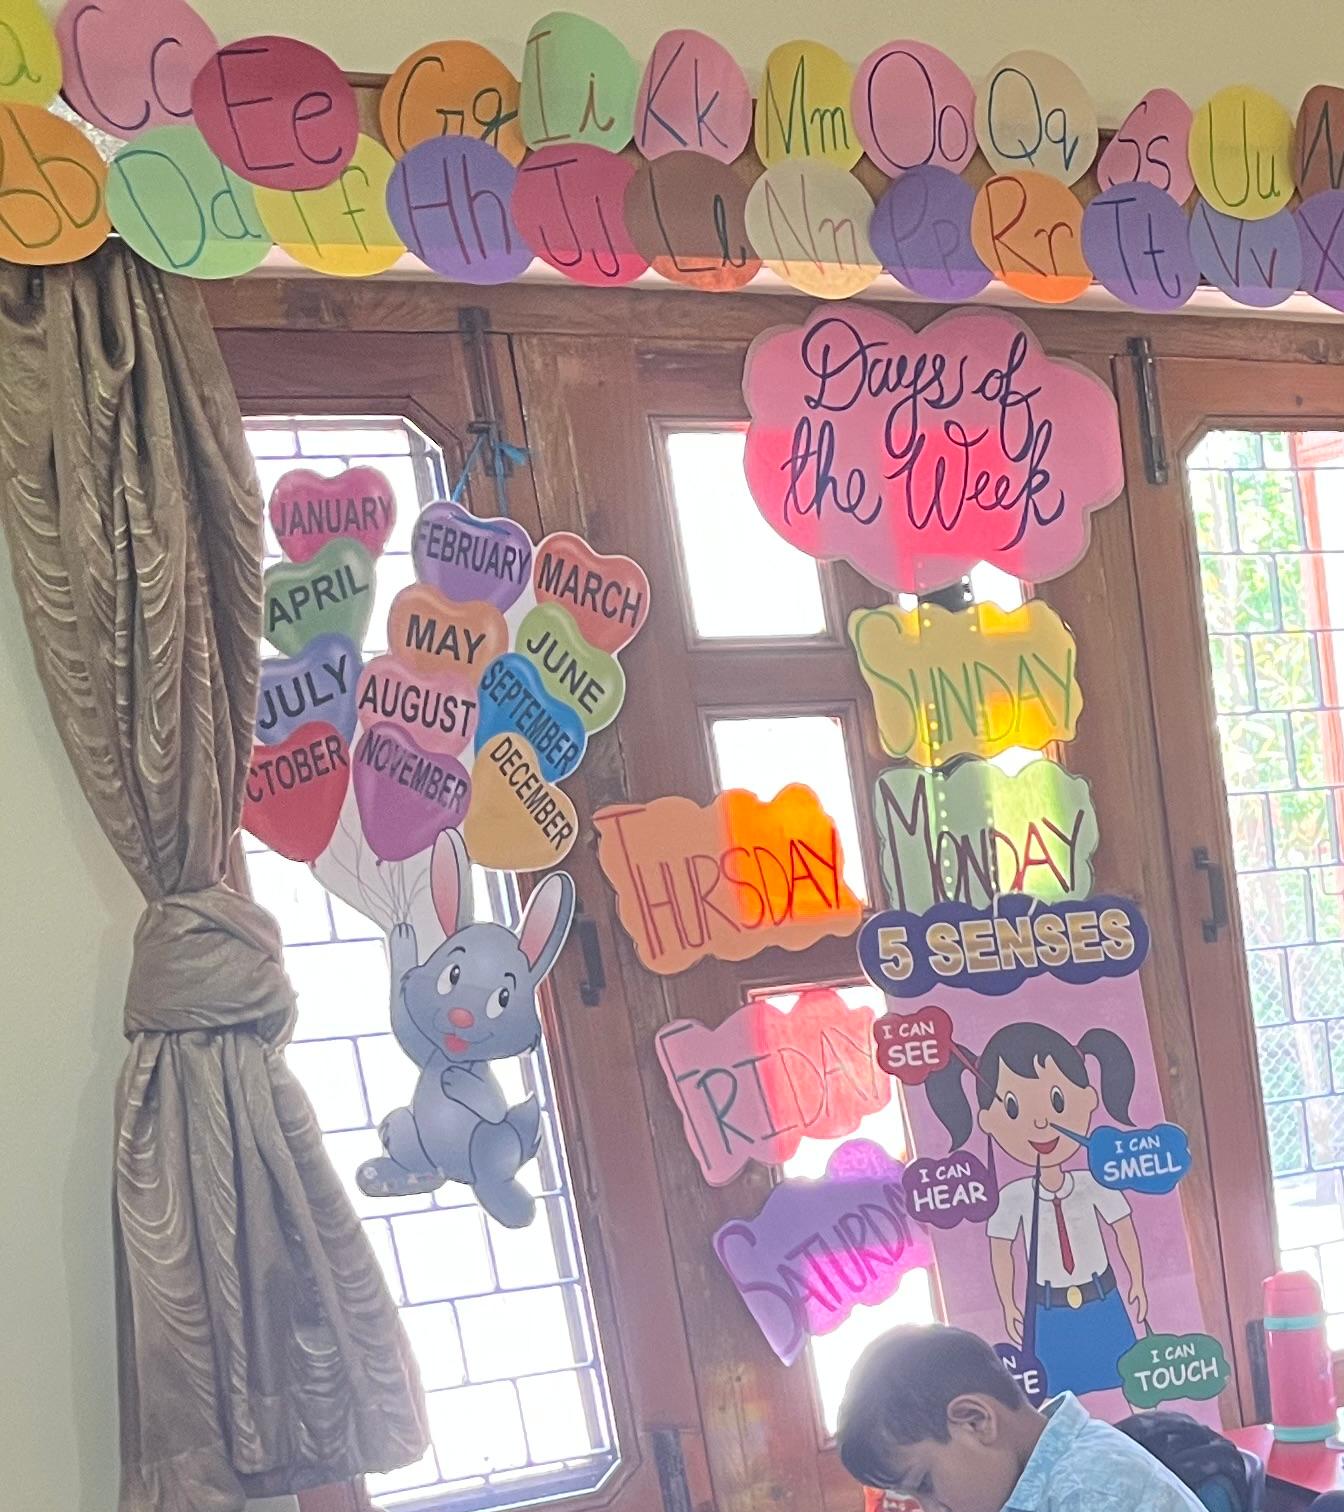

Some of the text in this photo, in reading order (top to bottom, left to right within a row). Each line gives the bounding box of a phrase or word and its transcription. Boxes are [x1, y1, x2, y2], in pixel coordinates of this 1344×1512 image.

[73, 4, 193, 130] Cc
[216, 48, 343, 171] Ee
[526, 30, 614, 144] Ii
[642, 41, 729, 149] Kk
[765, 54, 850, 158] Mm
[867, 50, 968, 170] Oo
[988, 68, 1079, 171] Qq
[1107, 101, 1171, 192] Ss
[1208, 100, 1281, 207] Uu
[114, 150, 261, 269] Dd
[402, 153, 512, 265] Hh
[521, 158, 620, 277] Jj
[650, 167, 746, 273] Ll
[765, 174, 864, 276] Nn
[889, 173, 961, 288] Pp
[985, 176, 1074, 278] Rr
[1092, 198, 1181, 299] Tt
[1201, 202, 1277, 289] Vv
[801, 318, 1042, 462] Days of
[275, 495, 390, 537] JANUARY
[781, 415, 1065, 551] the Week
[268, 564, 369, 632] APRIL
[416, 519, 531, 585] FEBRUARY
[538, 552, 643, 630] MARCH
[405, 614, 487, 665] MAY
[526, 631, 605, 715] JUNE
[854, 610, 1073, 755] SUNDAY
[259, 653, 349, 730] JULY
[358, 674, 477, 738] AUGUST
[480, 659, 584, 777] SEPTEMBER
[246, 734, 348, 802] CTOBER
[359, 728, 469, 815] NOVEMBER
[488, 736, 573, 851] DECEMBER
[592, 807, 845, 960] THURSDAY
[878, 774, 1085, 905] MONDAY
[878, 910, 1136, 980] 5 SENSES
[882, 1020, 936, 1039] I CAN
[887, 1040, 940, 1068] SEE
[659, 1014, 880, 1171] FRIDAY
[919, 1162, 972, 1184] I CAN
[1102, 1153, 1183, 1183] SMELL
[1114, 1136, 1161, 1153] I CAN
[912, 1181, 989, 1213] HEAR
[716, 1183, 920, 1356] SATURDA
[1133, 1357, 1219, 1393] TOUCH
[1150, 1343, 1196, 1364] I CAN
